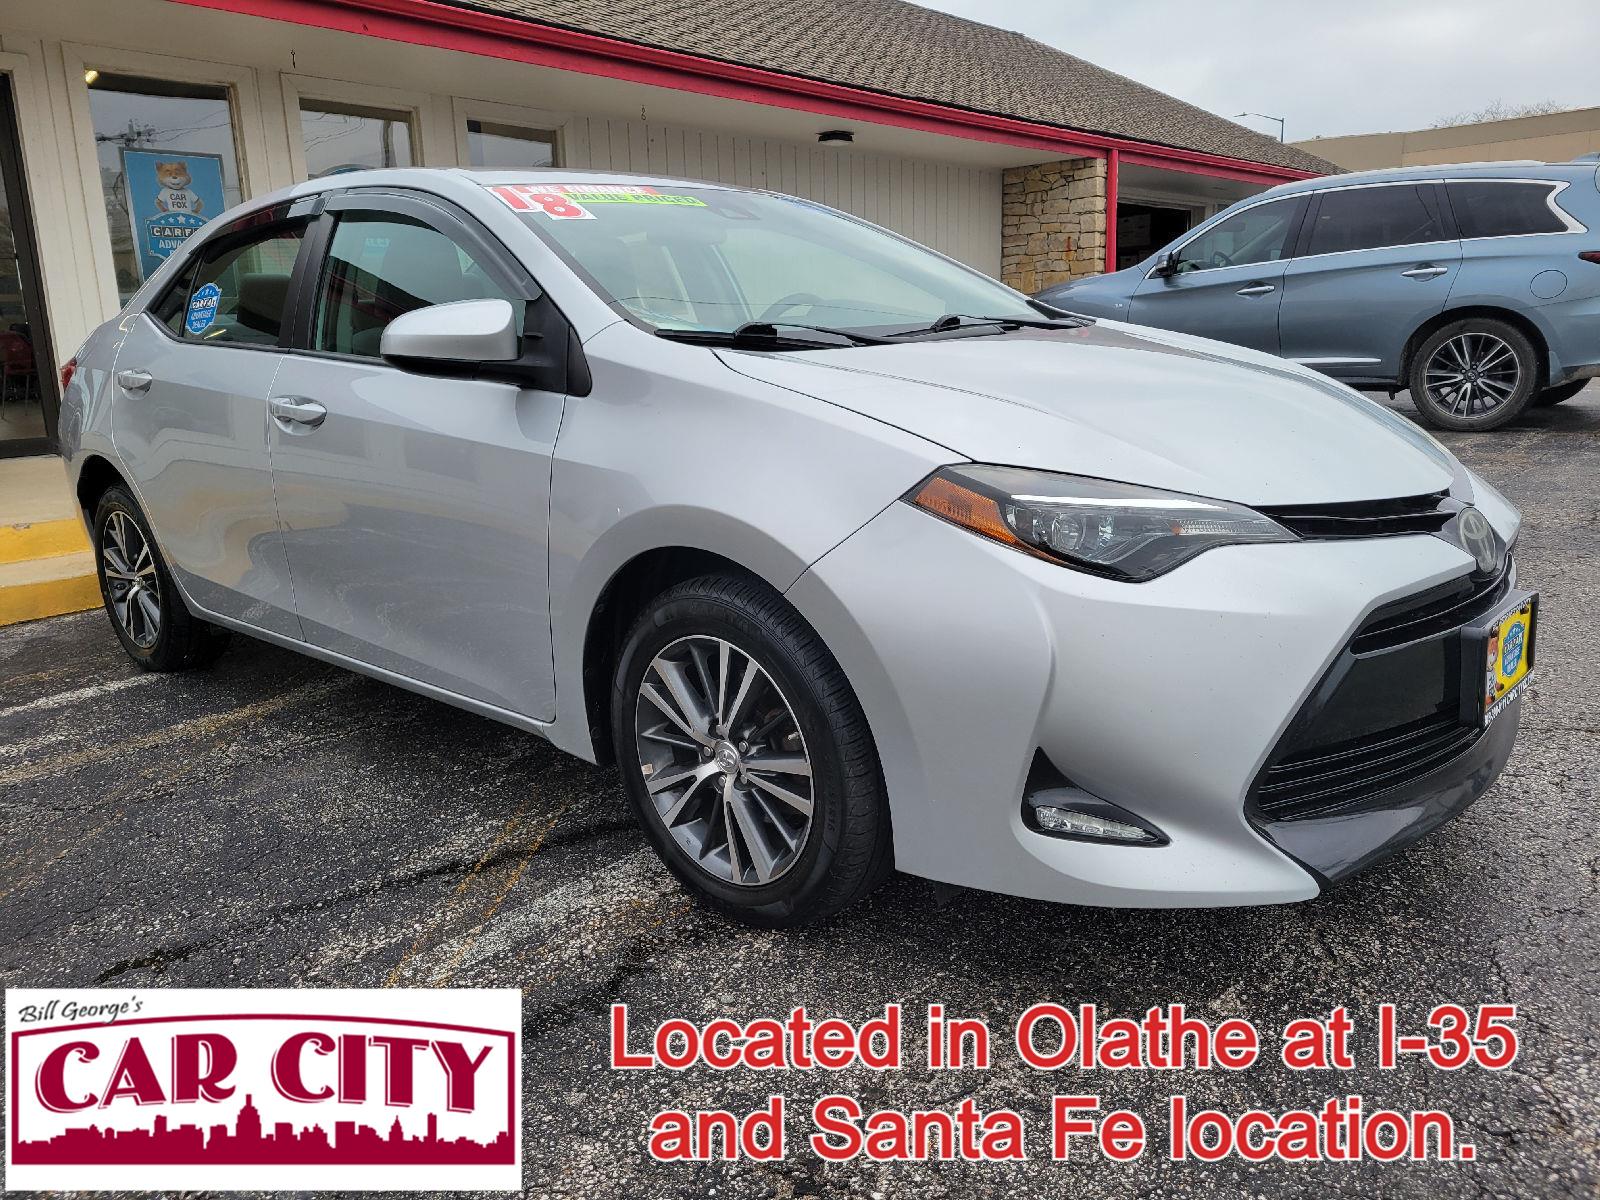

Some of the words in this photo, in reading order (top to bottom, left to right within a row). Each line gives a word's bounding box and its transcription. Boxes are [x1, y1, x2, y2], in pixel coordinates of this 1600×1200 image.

[169, 193, 187, 201] CAR
[564, 193, 627, 202] VALUE
[171, 201, 188, 209] FOX
[153, 228, 198, 236] CARF
